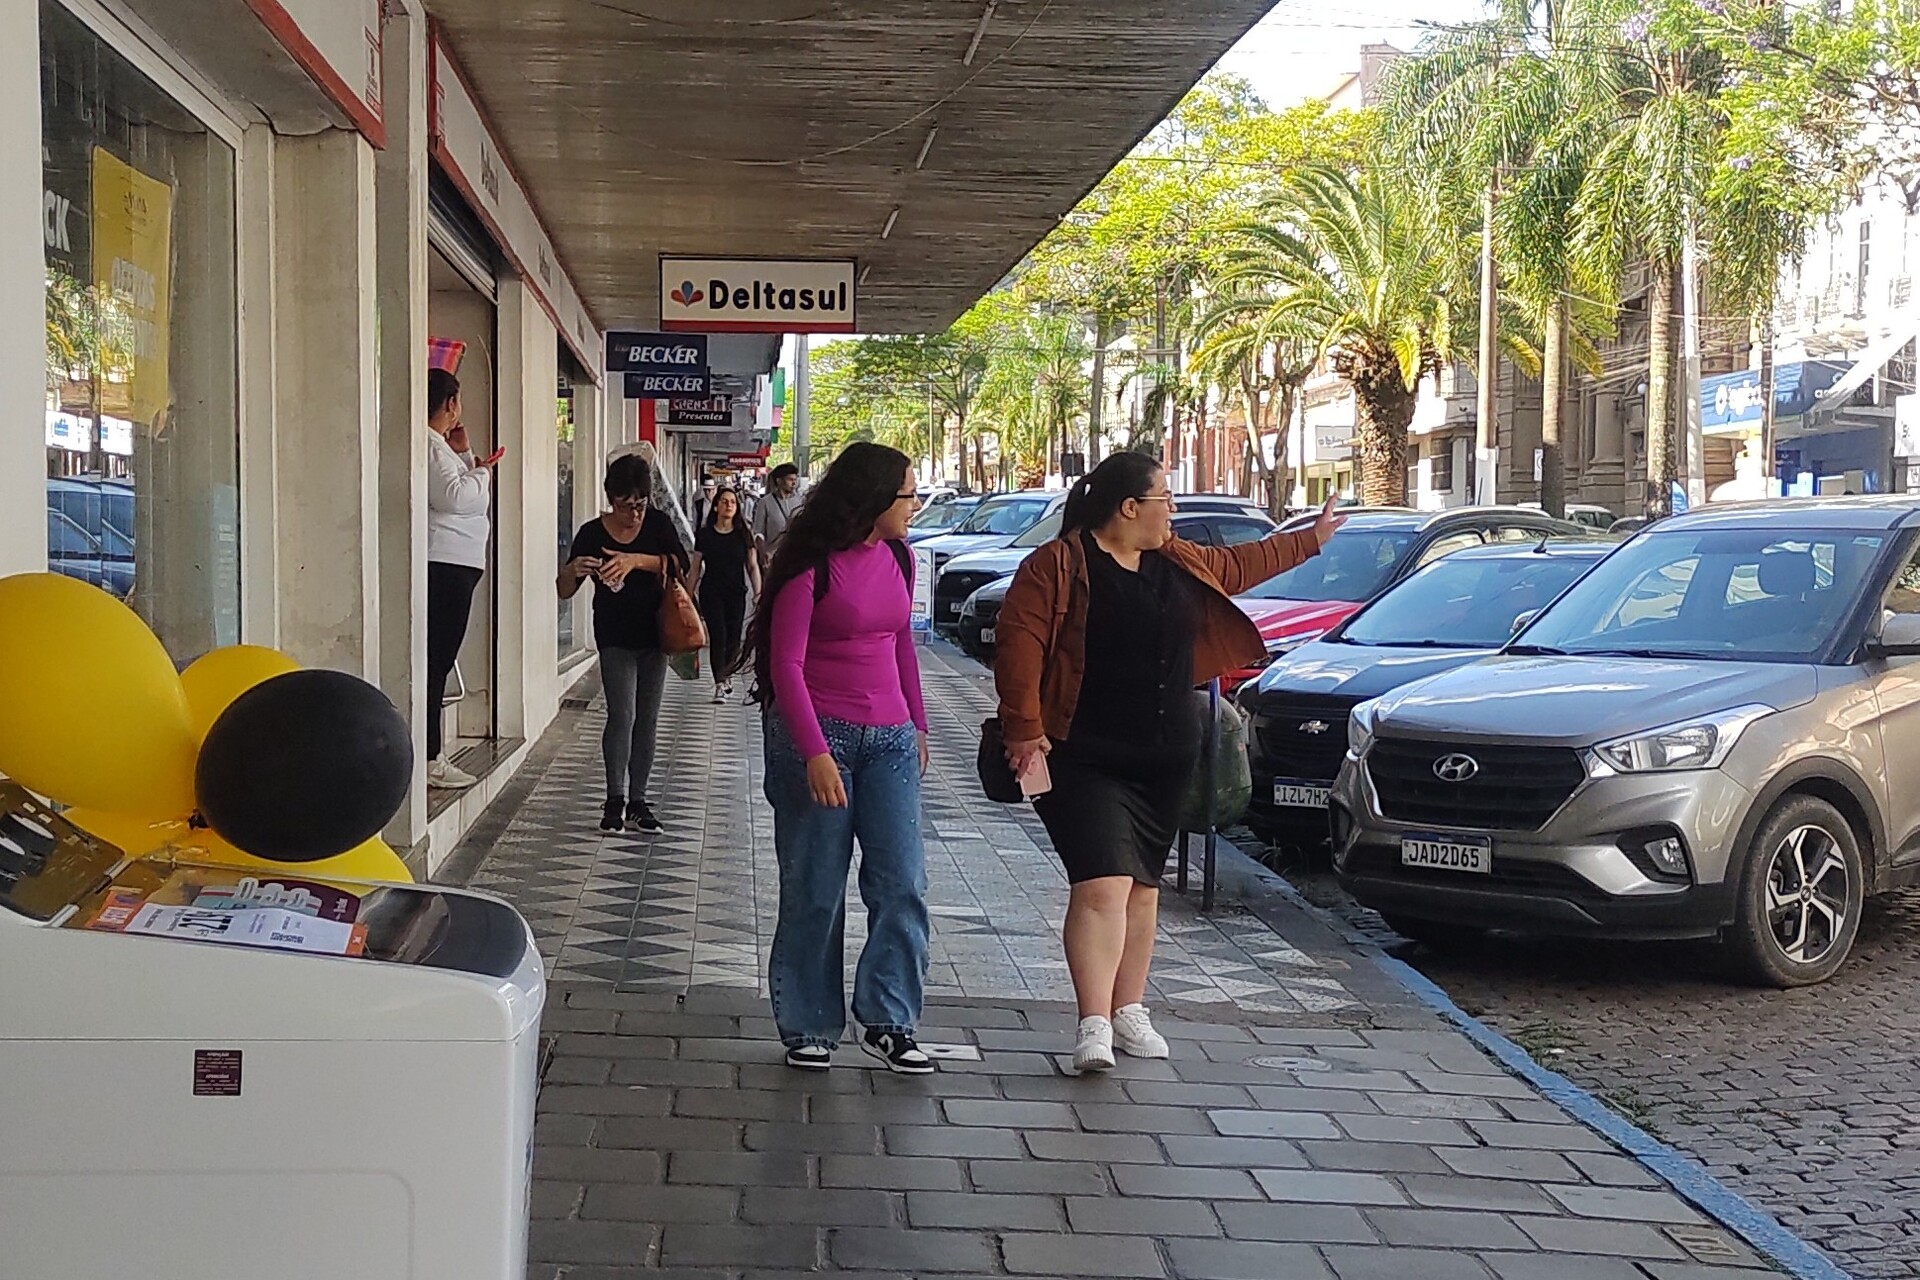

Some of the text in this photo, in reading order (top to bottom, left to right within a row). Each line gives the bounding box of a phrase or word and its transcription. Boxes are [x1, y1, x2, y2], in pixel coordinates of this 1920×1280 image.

[709, 280, 846, 311] Deltasul
[628, 344, 698, 364] BECKER
[643, 376, 704, 392] BECKER
[678, 411, 724, 421] Presentes
[1409, 842, 1480, 868] JAD2D65
